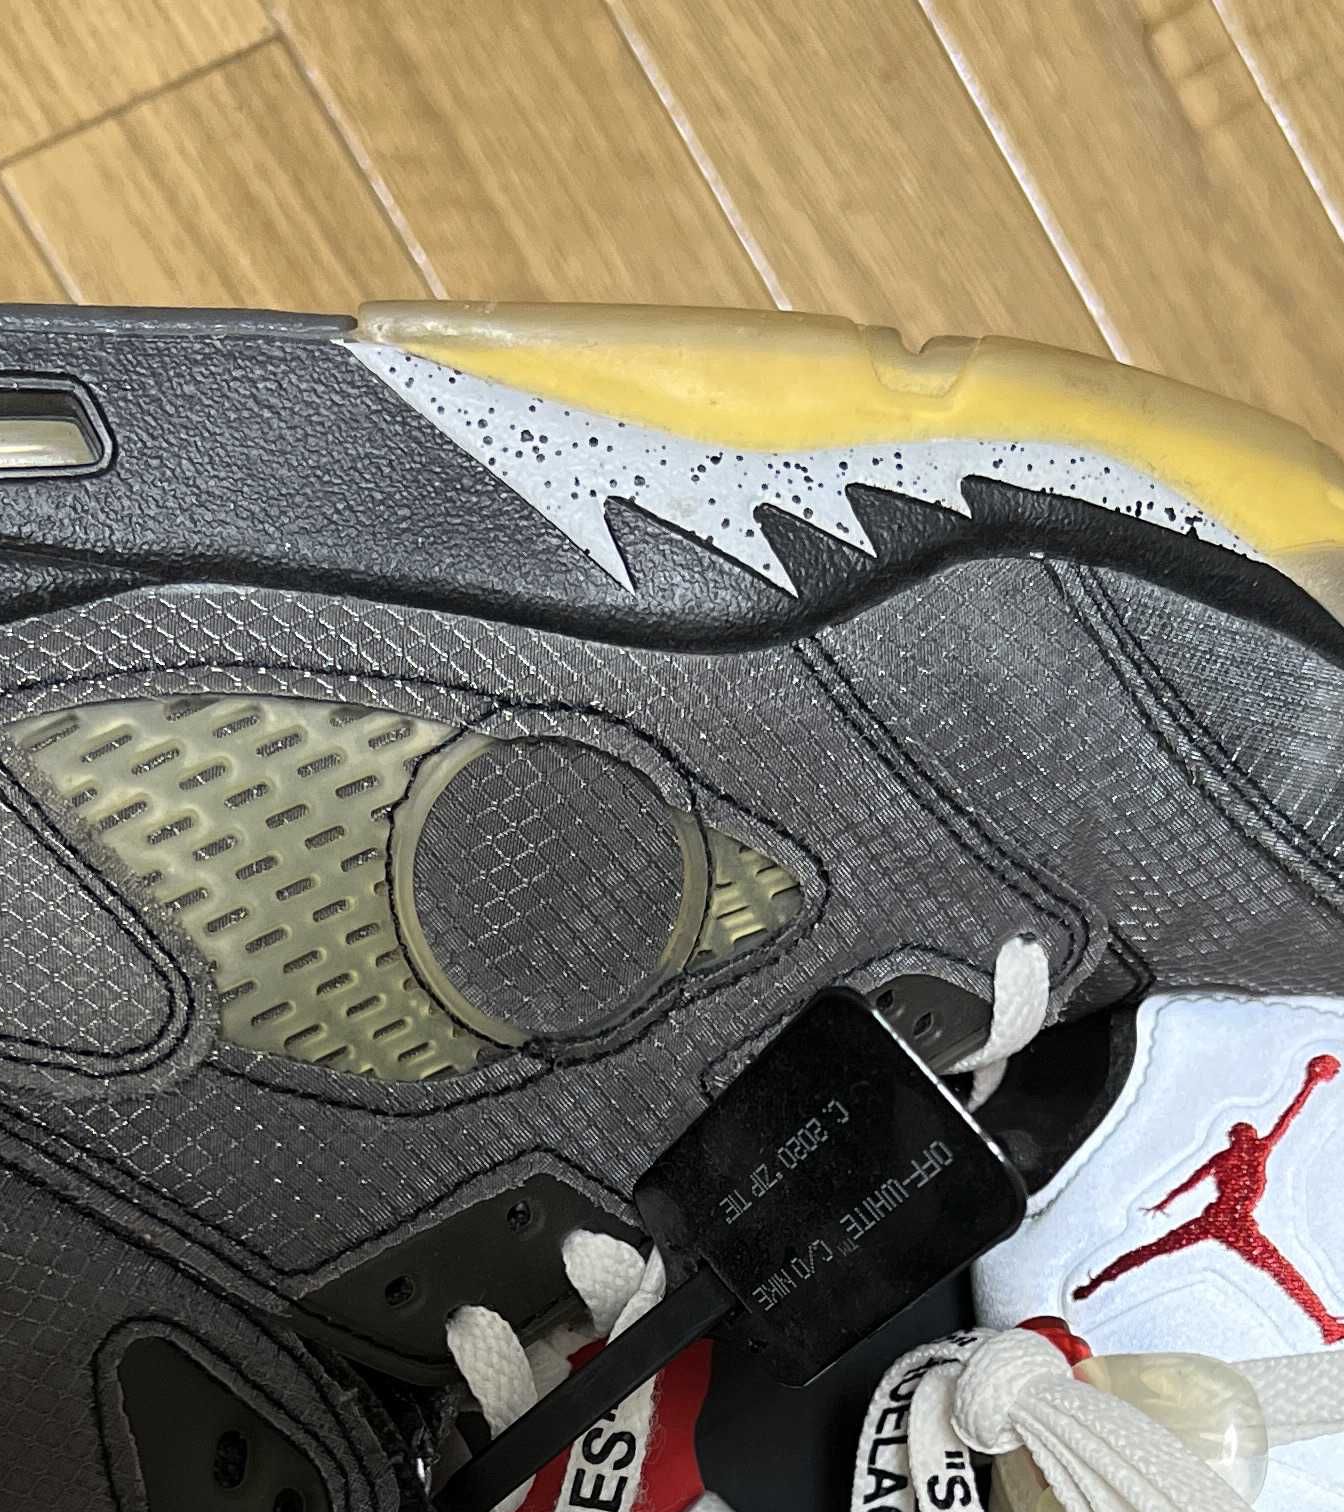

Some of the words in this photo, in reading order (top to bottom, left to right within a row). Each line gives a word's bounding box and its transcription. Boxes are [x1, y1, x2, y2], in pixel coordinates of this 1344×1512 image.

[777, 1117, 829, 1170] 2020
[790, 1239, 834, 1281] C/O
[752, 1268, 797, 1312] NIKE
